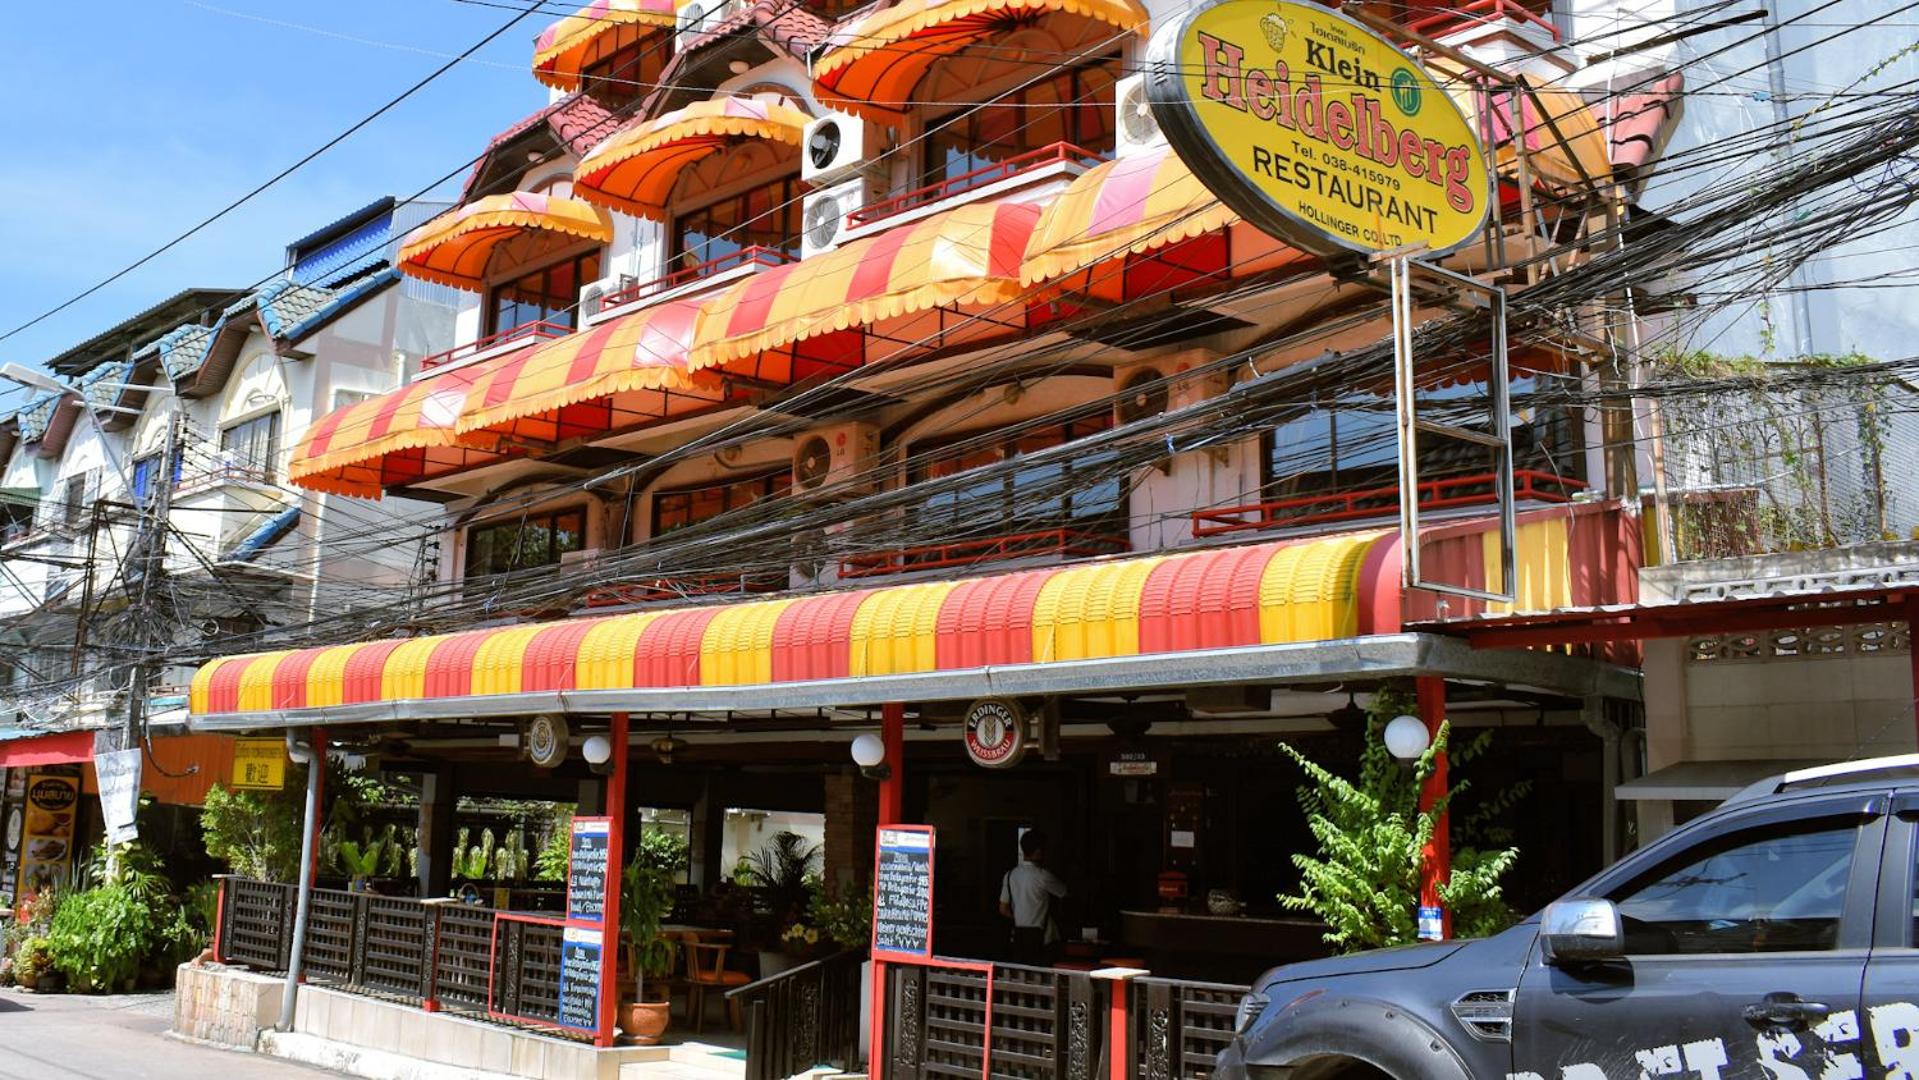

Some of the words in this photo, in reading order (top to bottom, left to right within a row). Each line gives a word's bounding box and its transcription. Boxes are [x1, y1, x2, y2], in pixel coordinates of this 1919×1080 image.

[1304, 37, 1381, 93] Klein
[1197, 30, 1475, 215] Heidelberg
[1252, 145, 1438, 235] RESTAURANT
[1291, 140, 1317, 160] Tel.
[1322, 152, 1401, 191] 038-415979
[1298, 200, 1359, 237] HOLLINGER
[968, 704, 1013, 729] ERDINGER
